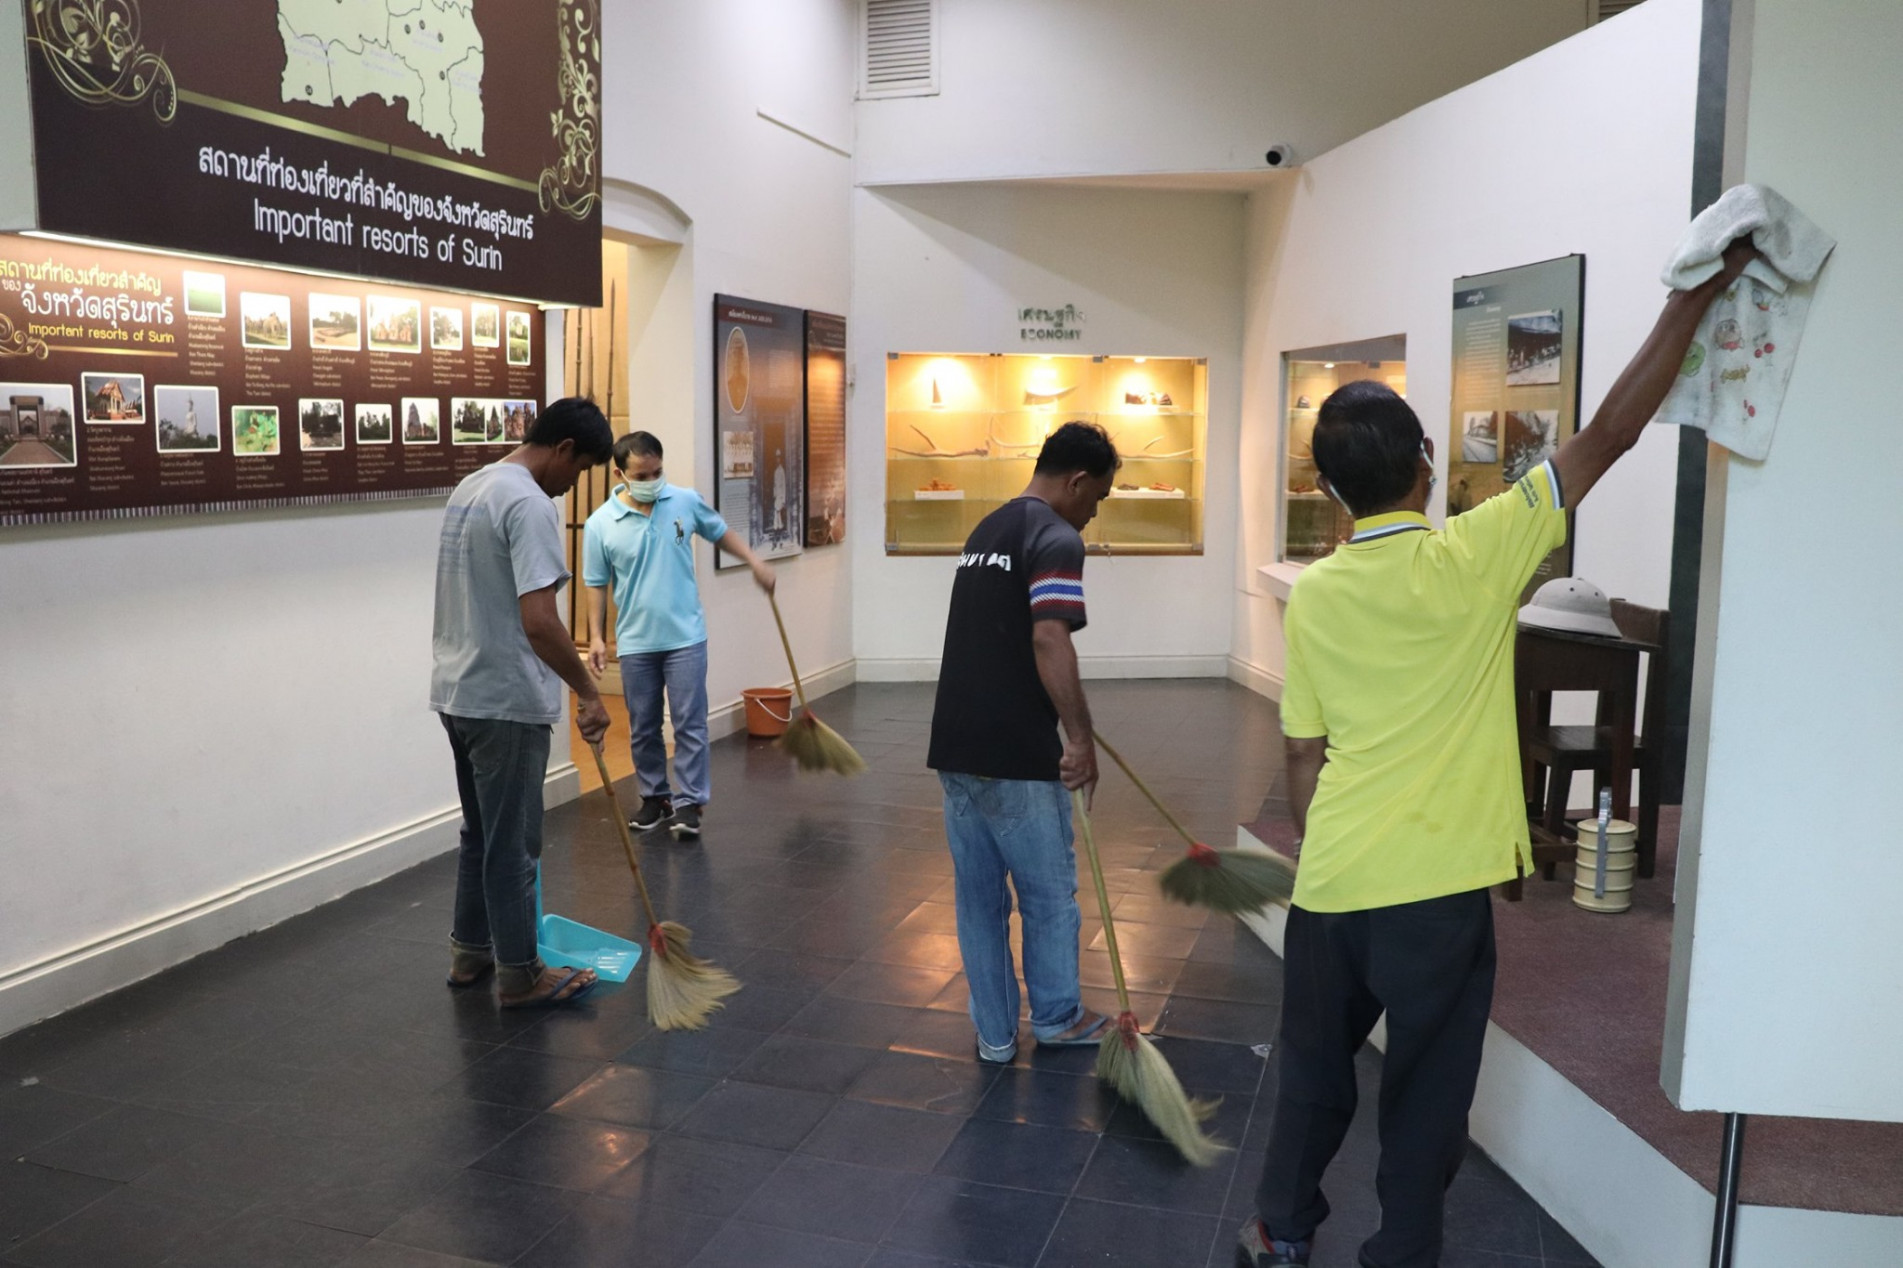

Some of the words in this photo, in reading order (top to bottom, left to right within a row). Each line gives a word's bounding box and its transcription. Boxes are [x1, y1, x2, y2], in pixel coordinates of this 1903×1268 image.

[199, 146, 534, 241] สถานที่ท่องเที่ยวที่สำคัญของจังหวัดสุรินทร์
[254, 198, 354, 246] Important
[363, 226, 429, 259] resorts
[437, 234, 455, 263] of
[462, 238, 503, 271] Surin
[2, 278, 21, 292] ของ
[21, 282, 175, 329] จังหวัดสุรินทร์
[28, 322, 84, 338] Important
[88, 328, 129, 341] resorts
[133, 329, 145, 341] of
[148, 331, 175, 344] Surin
[1020, 328, 1081, 340] ECONOMY
